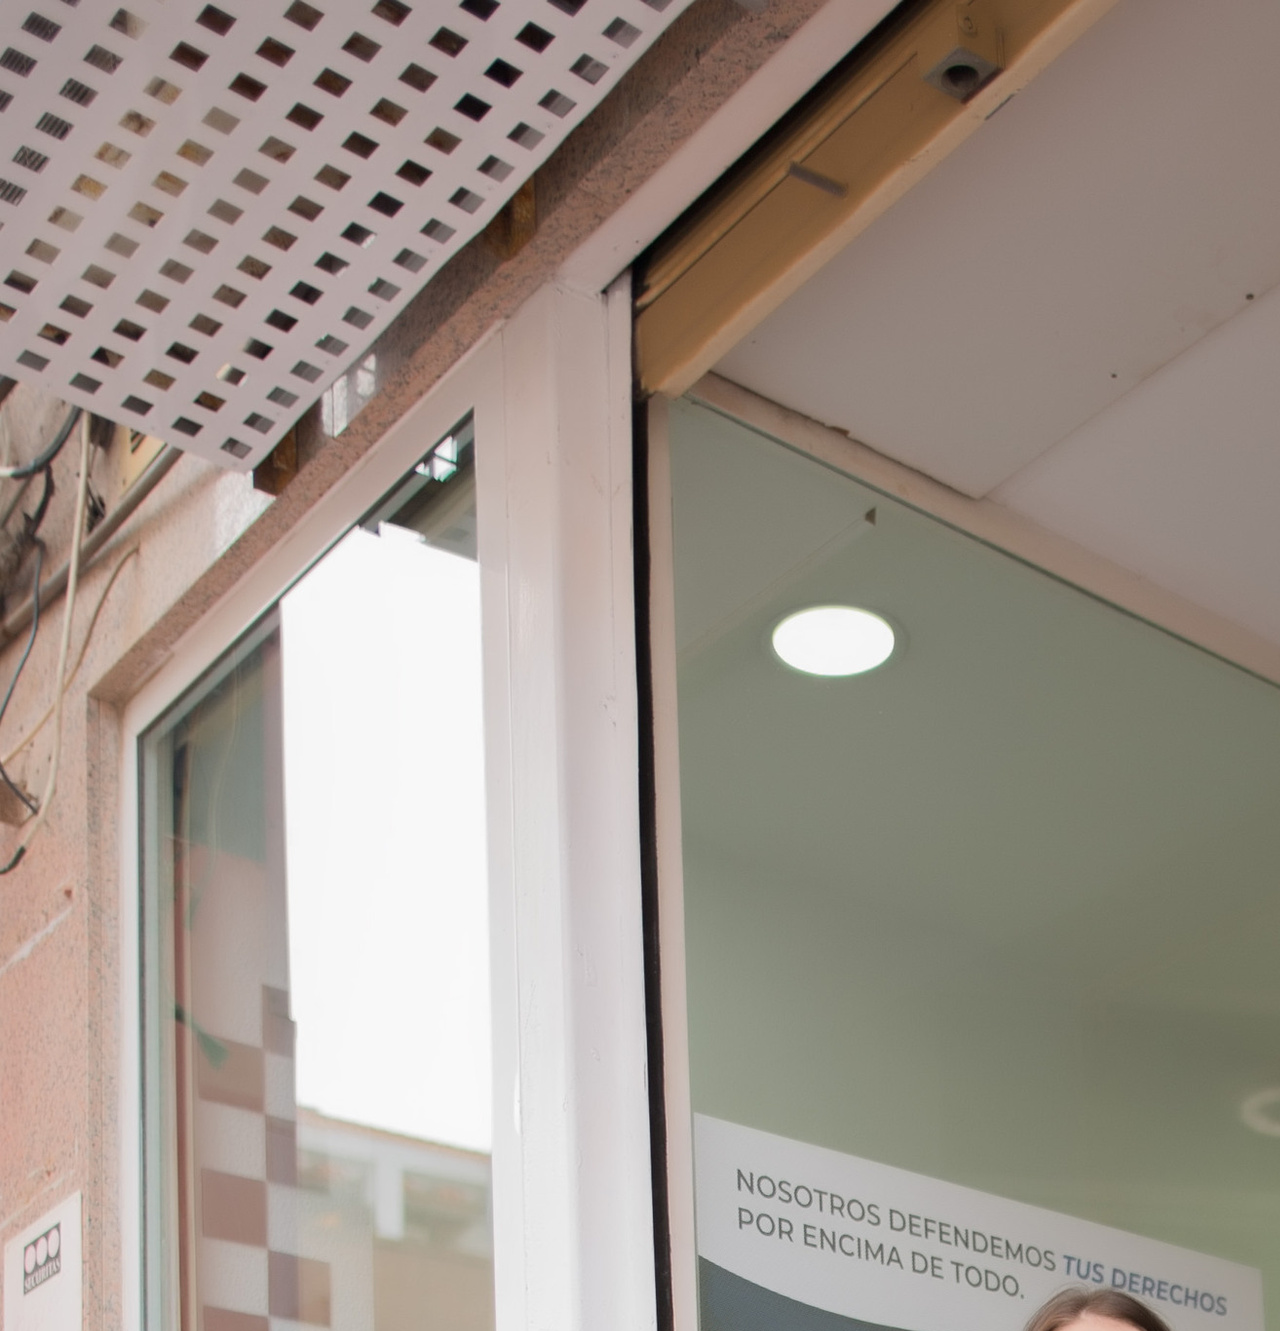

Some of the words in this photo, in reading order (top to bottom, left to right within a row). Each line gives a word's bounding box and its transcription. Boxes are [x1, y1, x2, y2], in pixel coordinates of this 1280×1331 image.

[24, 1258, 62, 1294] SECURITAS
[736, 1168, 882, 1227] NOSOTROS
[889, 1208, 1056, 1272] DEFENDEMOS
[1063, 1254, 1105, 1284] TUS
[1111, 1268, 1228, 1317] DERECHOS
[737, 1207, 795, 1242] POR
[803, 1224, 902, 1270] ENCIMA
[911, 1251, 944, 1279] DE
[950, 1261, 1026, 1299] TODO.
